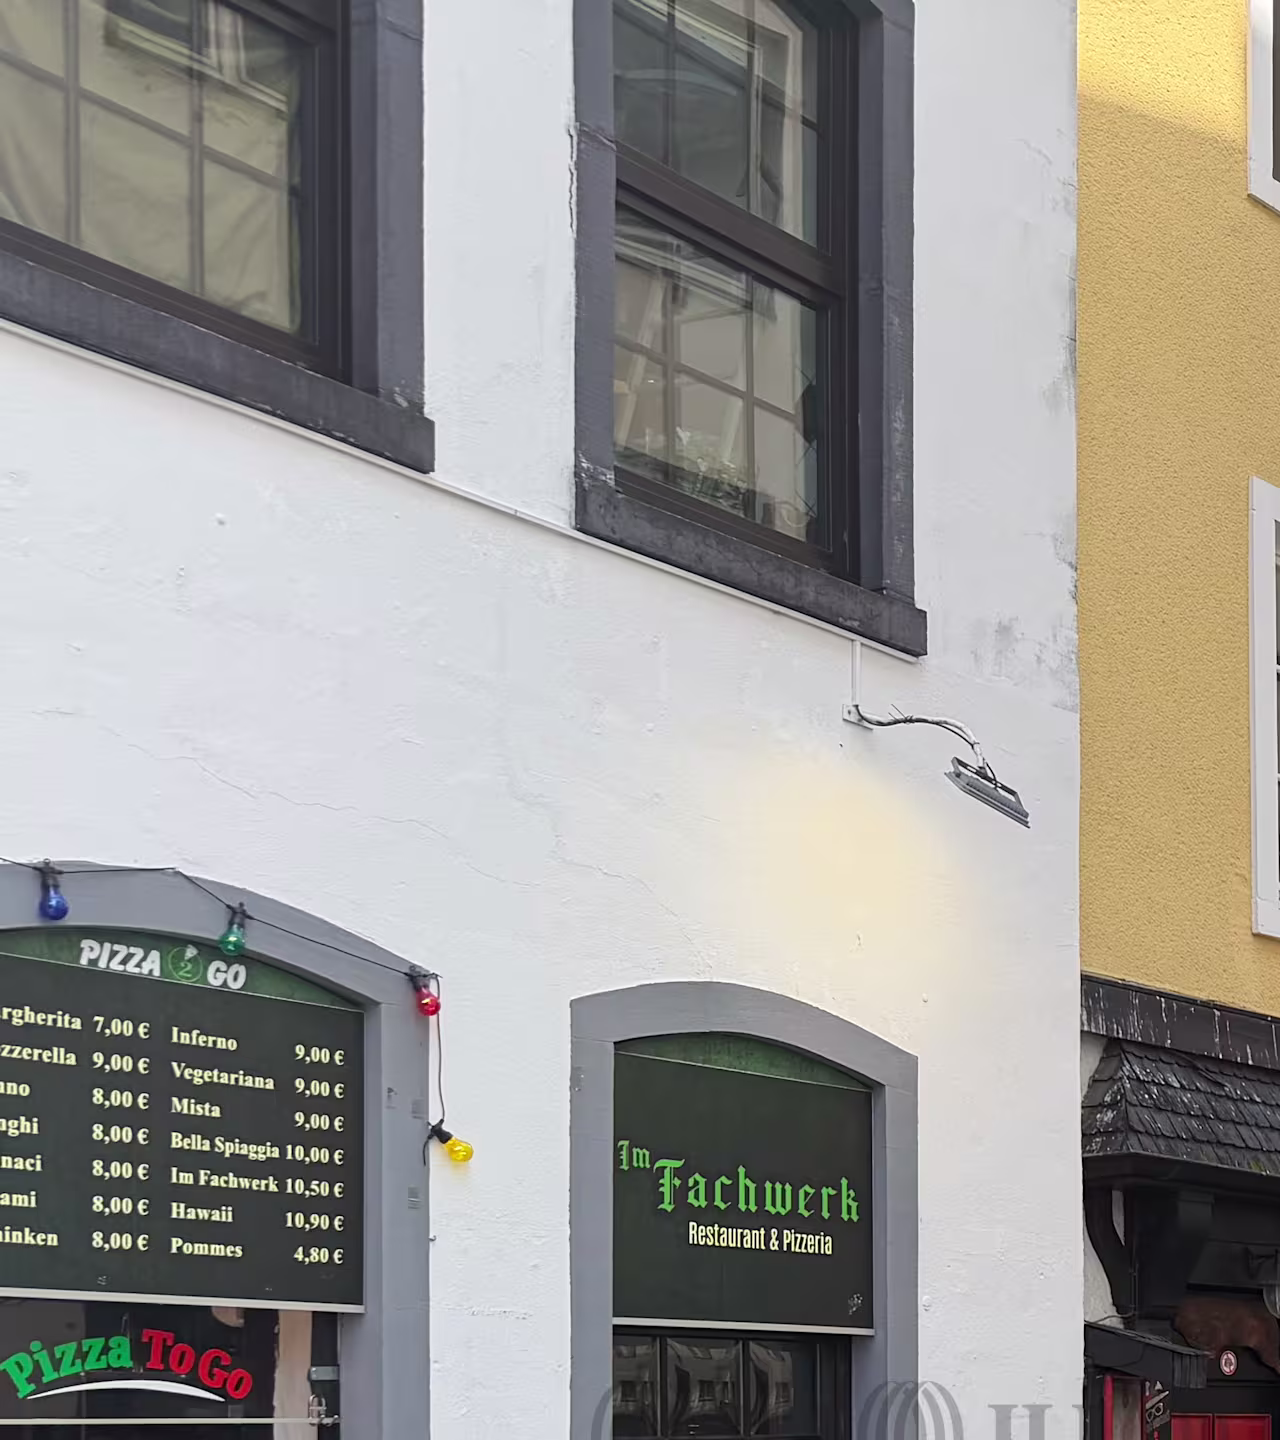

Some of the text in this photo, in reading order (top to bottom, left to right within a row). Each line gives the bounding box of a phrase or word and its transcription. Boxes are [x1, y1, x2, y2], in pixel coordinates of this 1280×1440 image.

[79, 938, 162, 976] PIZZA
[206, 960, 247, 990] GO
[0, 1006, 150, 1039] rgherita 7,00 €
[0, 1044, 150, 1074] zzerella 9,00 €
[171, 1027, 345, 1066] Inferno 9,00 €
[171, 1061, 345, 1099] Vegetariana 9,00 €
[92, 1087, 133, 1109] 8,00
[137, 1093, 150, 1110] €
[171, 1097, 345, 1133] Mista 9,00 €
[92, 1123, 133, 1145] 8,00
[137, 1128, 150, 1145] €
[171, 1131, 345, 1166] Bella Spiaggia 10,00 €
[92, 1159, 133, 1181] 8,00
[137, 1164, 150, 1181] €
[617, 1139, 651, 1172] Im
[171, 1166, 345, 1199] Im Fachwerk 10,50 €
[653, 1158, 860, 1223] Fachwerk
[92, 1195, 133, 1217] 8,00
[137, 1199, 150, 1216] €
[171, 1202, 345, 1232] Hawaii 10,90 €
[0, 1226, 150, 1253] inken 8,00 €
[171, 1237, 345, 1266] Pommes 4,80 €
[688, 1221, 833, 1255] Restaurant & Pizzeria
[0, 1335, 134, 1400] Pizza
